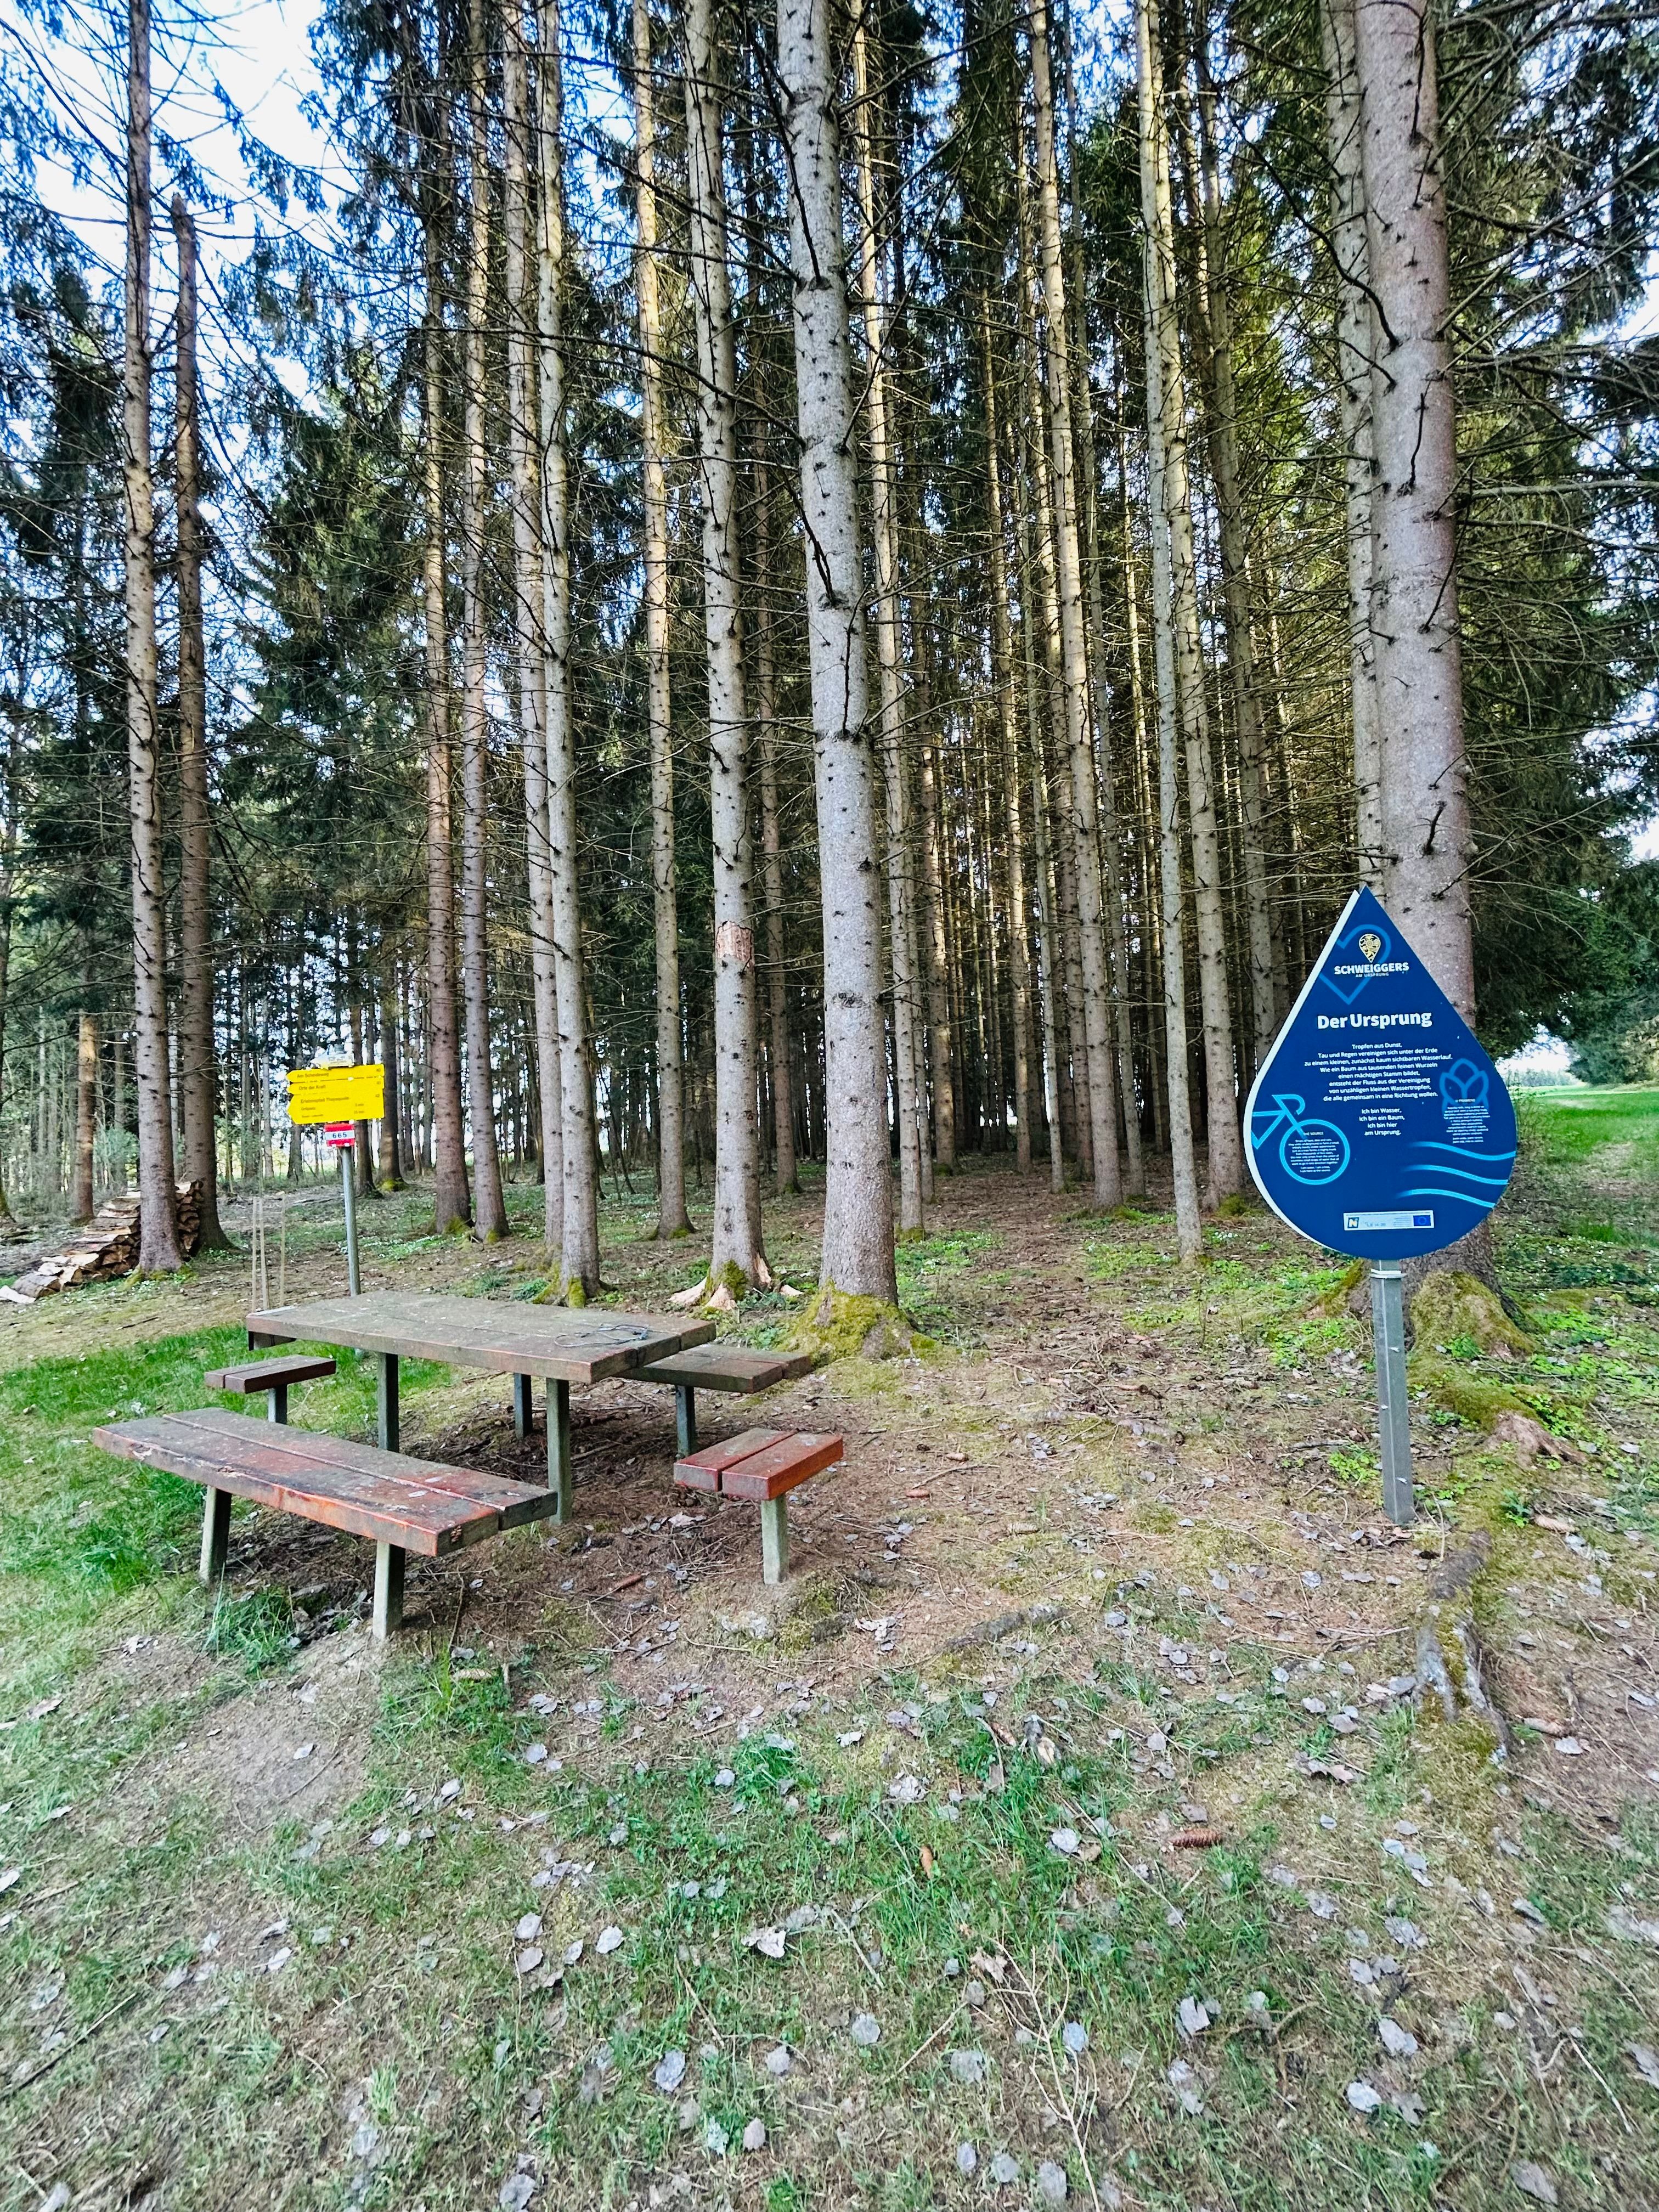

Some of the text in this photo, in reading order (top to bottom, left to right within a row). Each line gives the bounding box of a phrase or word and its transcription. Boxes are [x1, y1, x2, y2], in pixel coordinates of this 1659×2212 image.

[1334, 962, 1409, 975] SCHWEIGGERS
[1317, 1012, 1432, 1029] Der Ursprung
